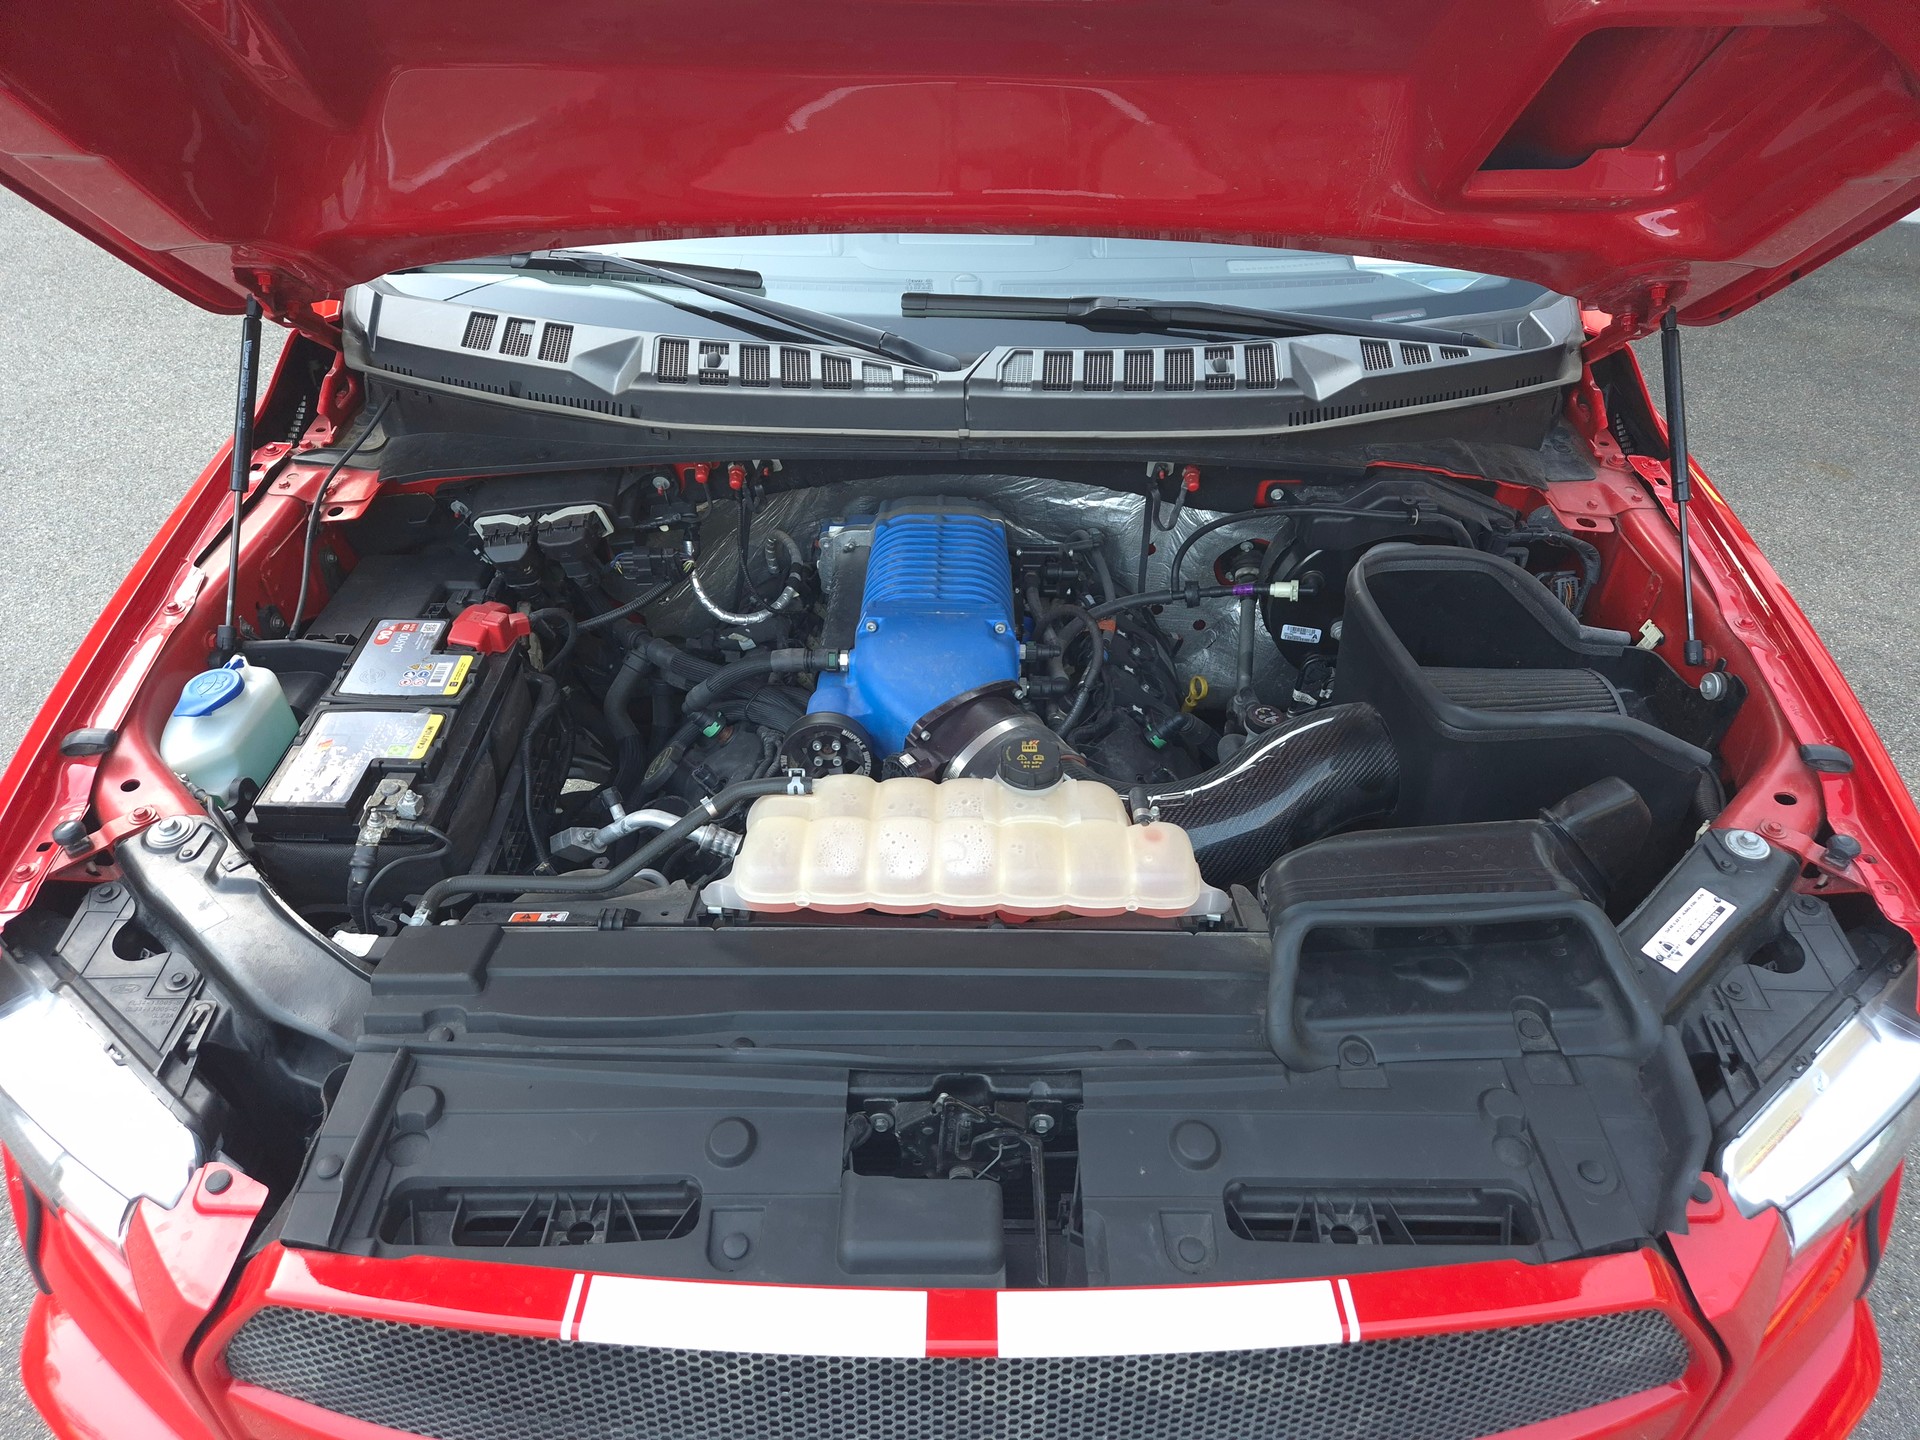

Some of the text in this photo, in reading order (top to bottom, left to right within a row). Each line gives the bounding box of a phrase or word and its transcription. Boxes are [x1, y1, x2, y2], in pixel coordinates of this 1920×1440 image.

[377, 630, 393, 640] 90
[390, 633, 411, 652] DA900
[417, 725, 435, 749] CAUTION
[841, 729, 866, 750] WHIPPLE
